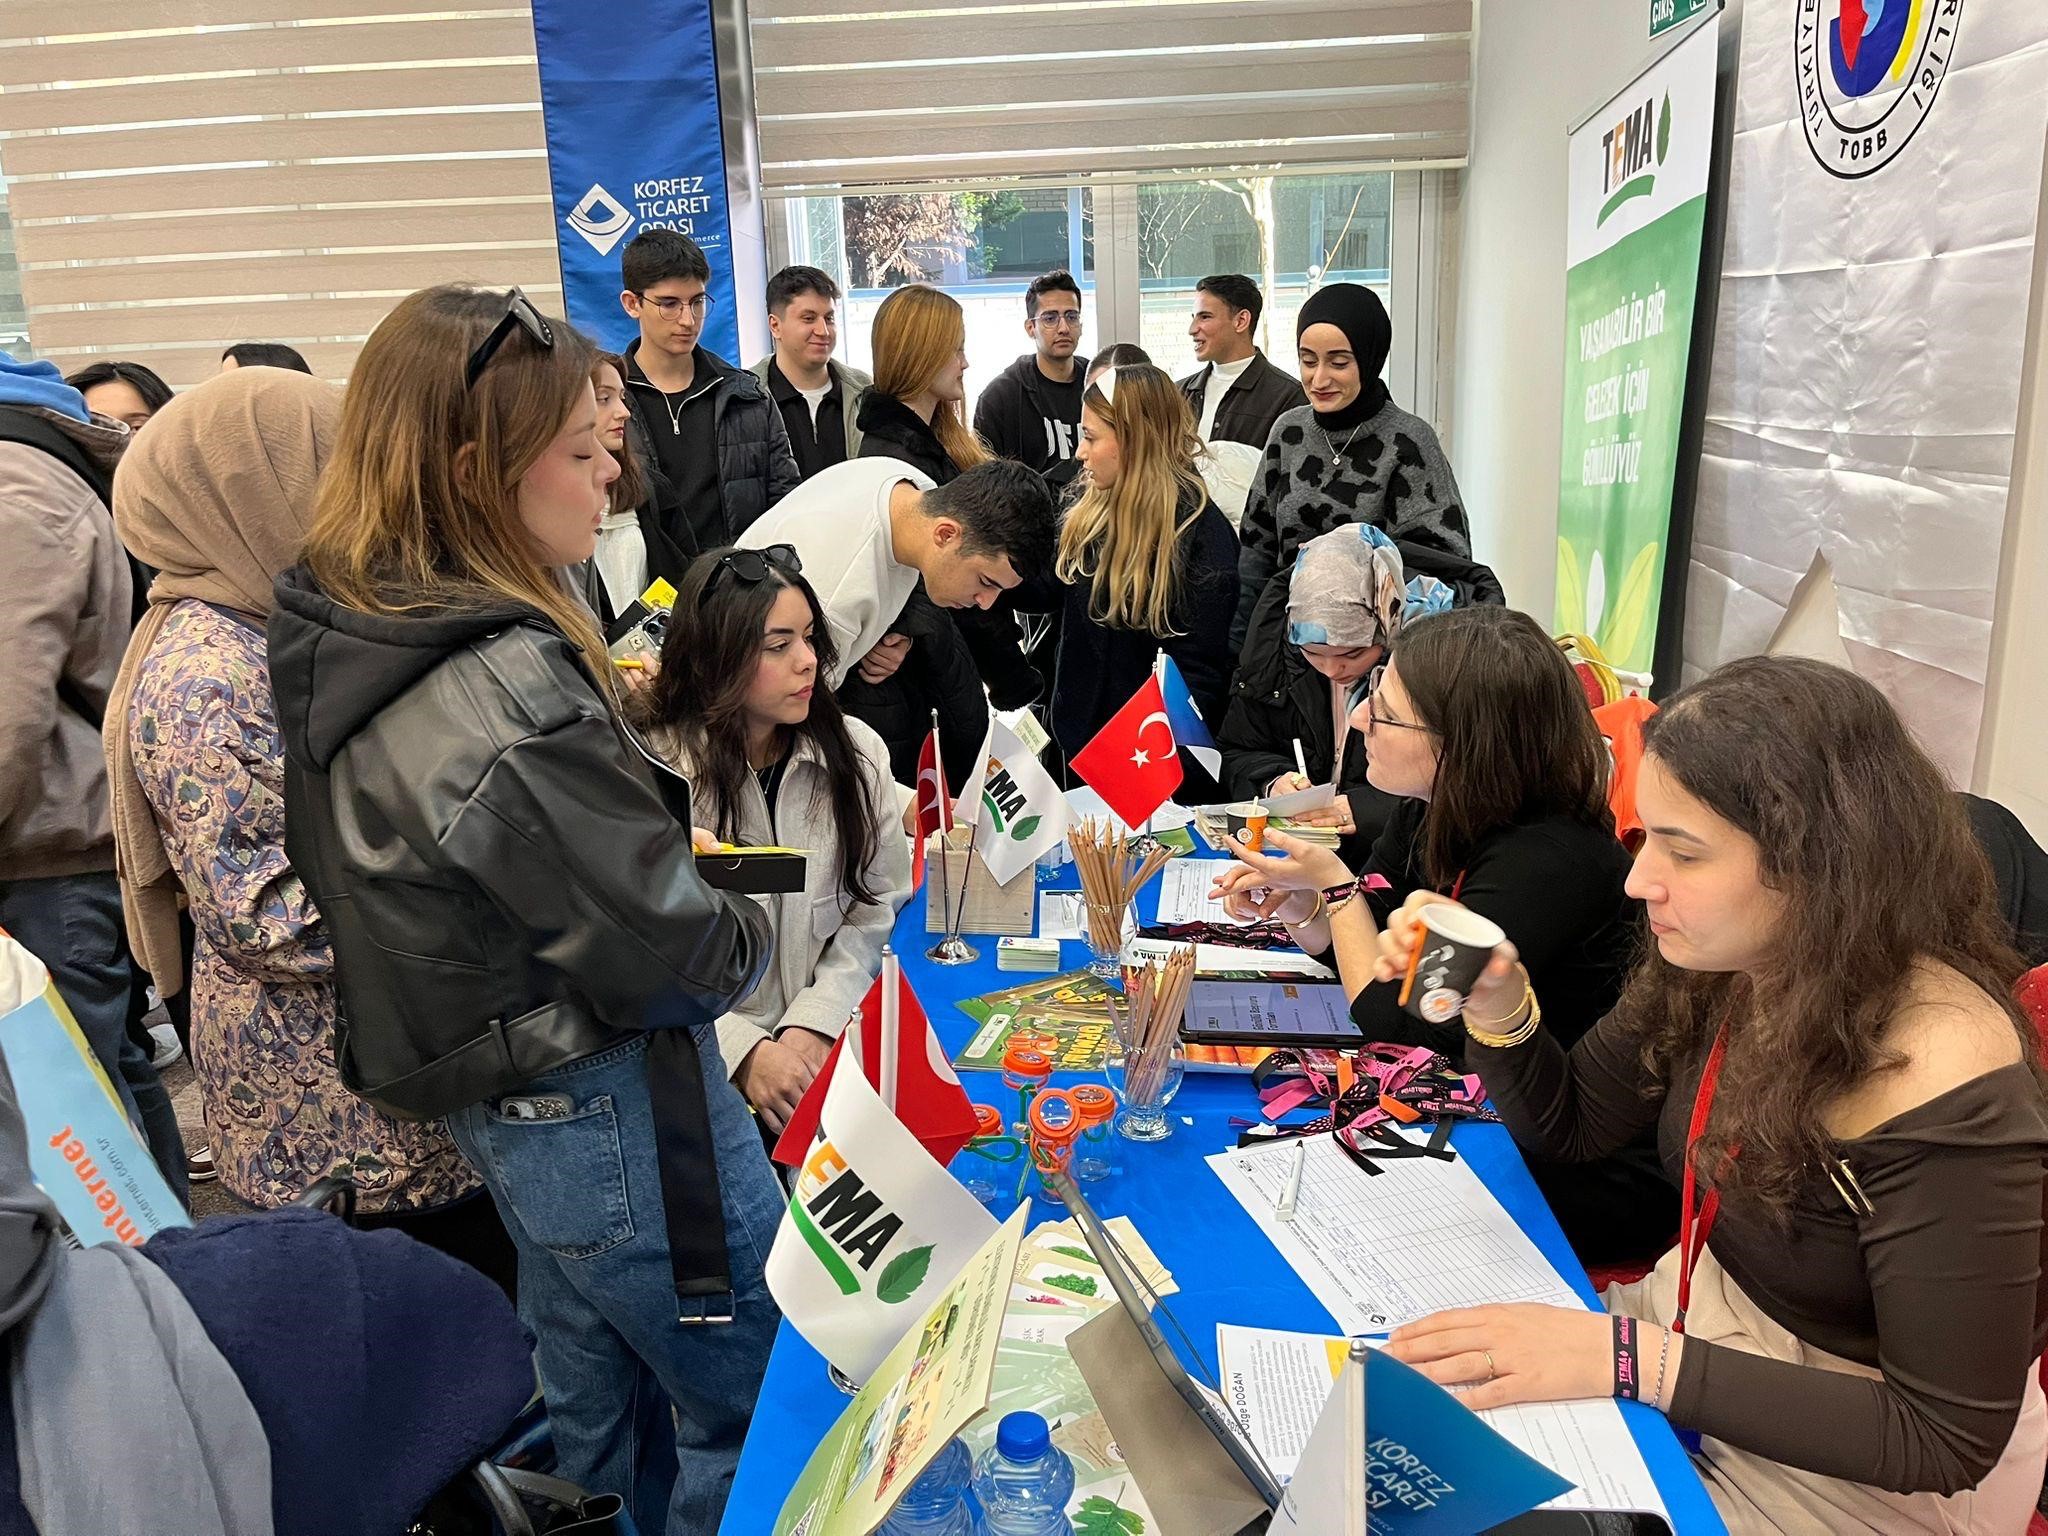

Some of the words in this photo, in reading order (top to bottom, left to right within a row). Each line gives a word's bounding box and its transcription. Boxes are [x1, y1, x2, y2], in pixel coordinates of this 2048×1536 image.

[1652, 0, 1675, 29] ÇIKIŞ
[1603, 98, 1653, 195] TEMA
[1840, 128, 1888, 161] TOBB
[1645, 282, 1666, 338] BİR
[1623, 360, 1650, 419] İÇİN
[984, 755, 1028, 823] EMA
[797, 1123, 904, 1272] EMA
[1232, 1372, 1247, 1406] DOĞAN
[1619, 1357, 1630, 1383] TEMA
